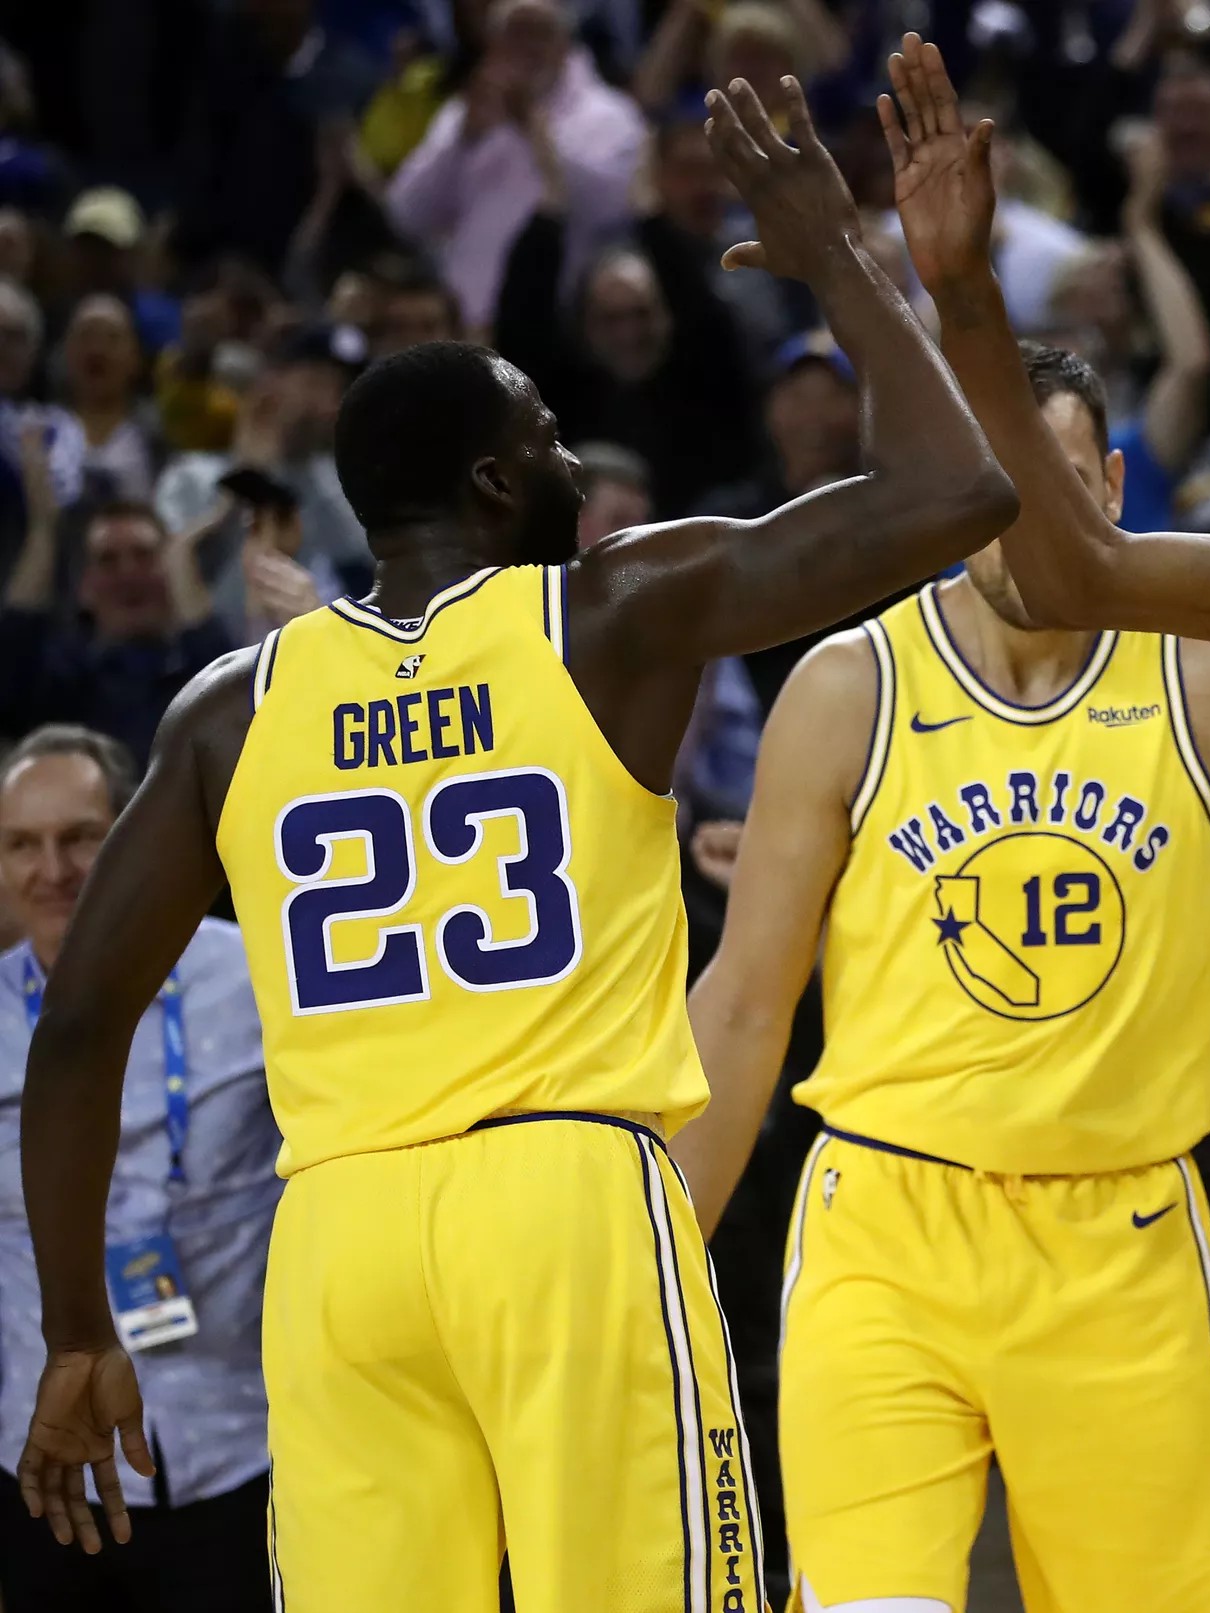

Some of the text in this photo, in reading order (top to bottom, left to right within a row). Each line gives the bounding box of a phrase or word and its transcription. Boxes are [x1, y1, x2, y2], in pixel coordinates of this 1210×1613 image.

[333, 683, 494, 770] GREEN
[1087, 704, 1161, 724] Rakuten
[888, 770, 1171, 873] WARRIORS
[274, 766, 583, 1016] 23
[1021, 872, 1101, 947] 12
[708, 1428, 745, 1613] WARRIO
